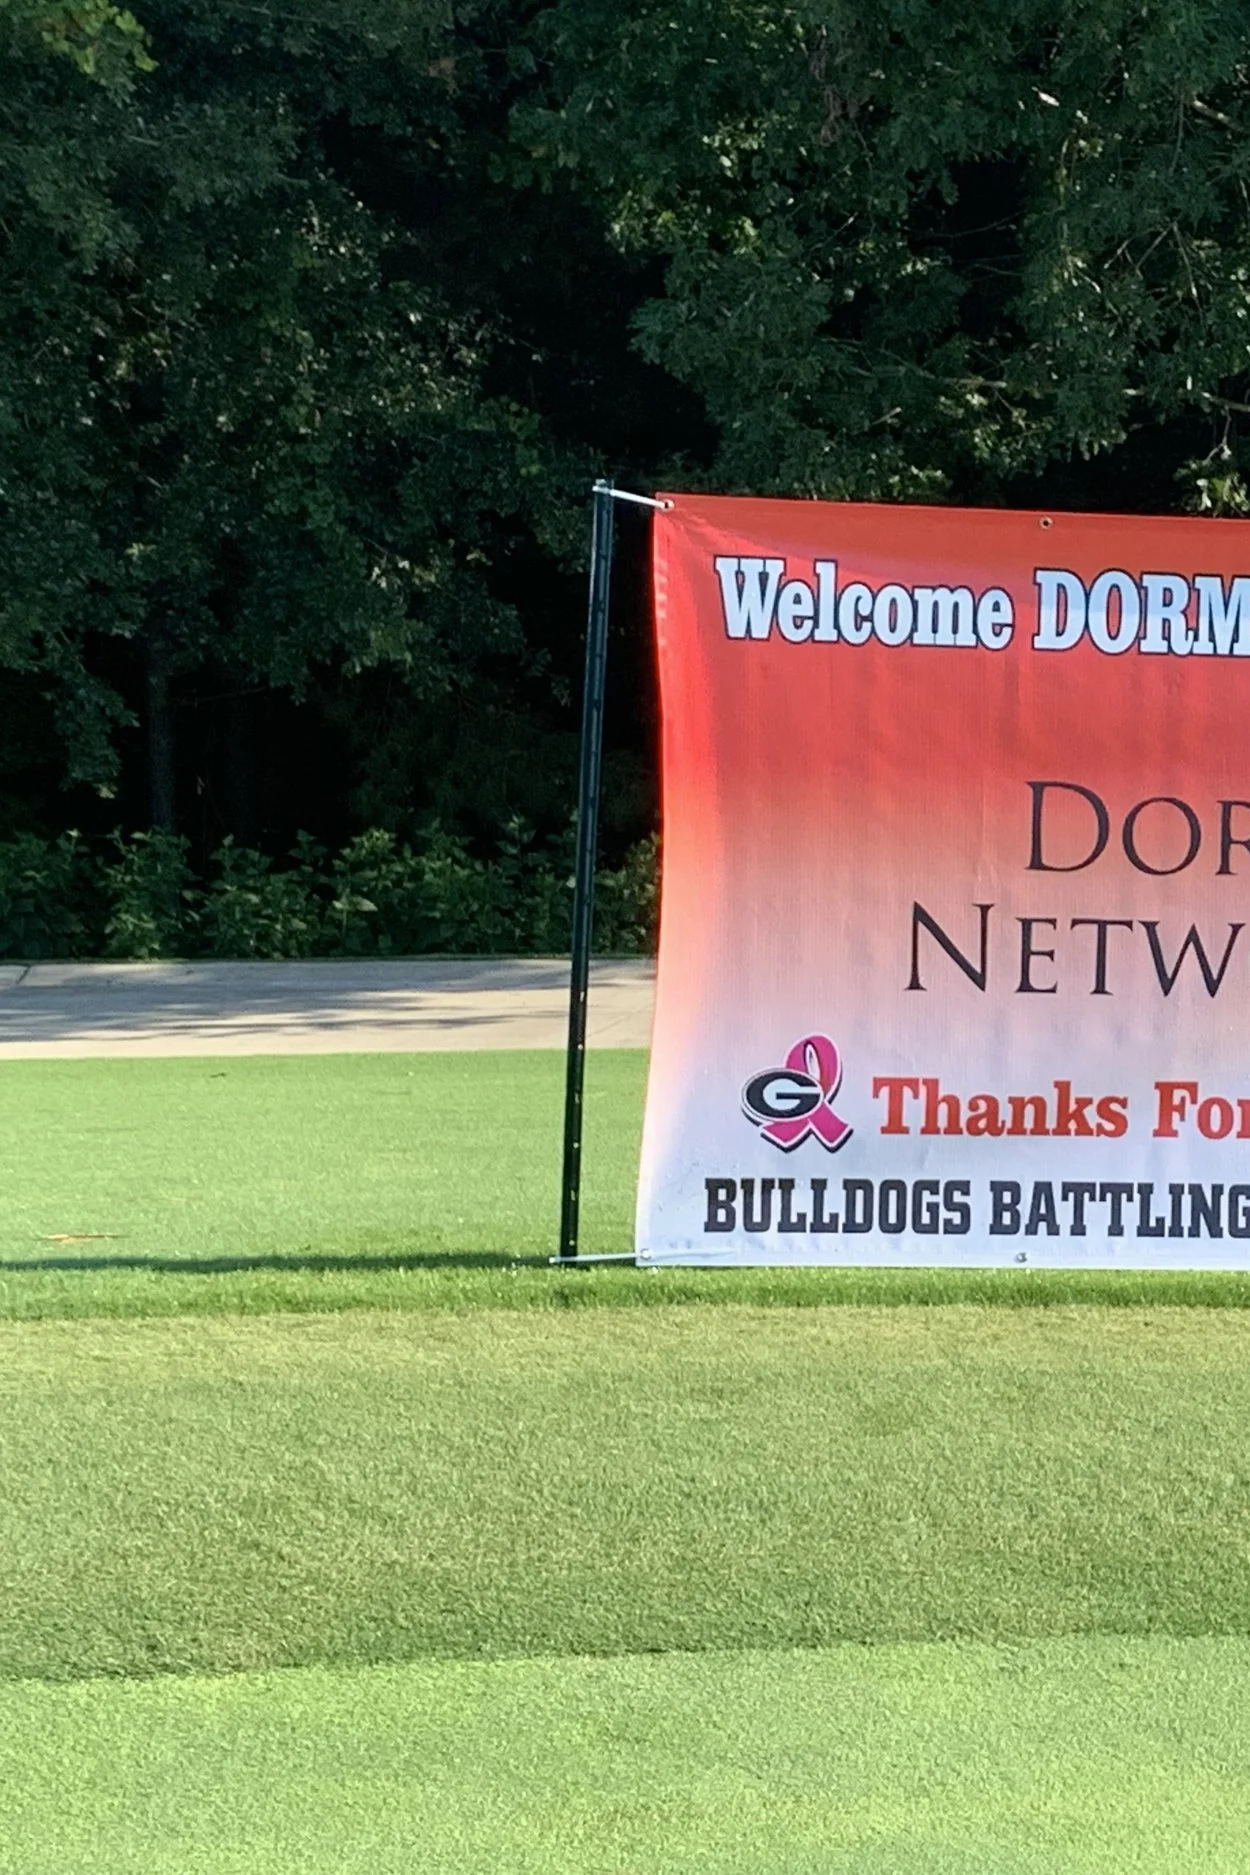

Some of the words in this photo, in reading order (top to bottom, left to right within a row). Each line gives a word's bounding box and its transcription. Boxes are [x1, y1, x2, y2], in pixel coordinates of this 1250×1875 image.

[713, 554, 1015, 652] Welcome
[745, 1070, 822, 1119] G
[872, 1076, 1128, 1138] Thanks
[704, 1177, 971, 1235] BULLDOGS
